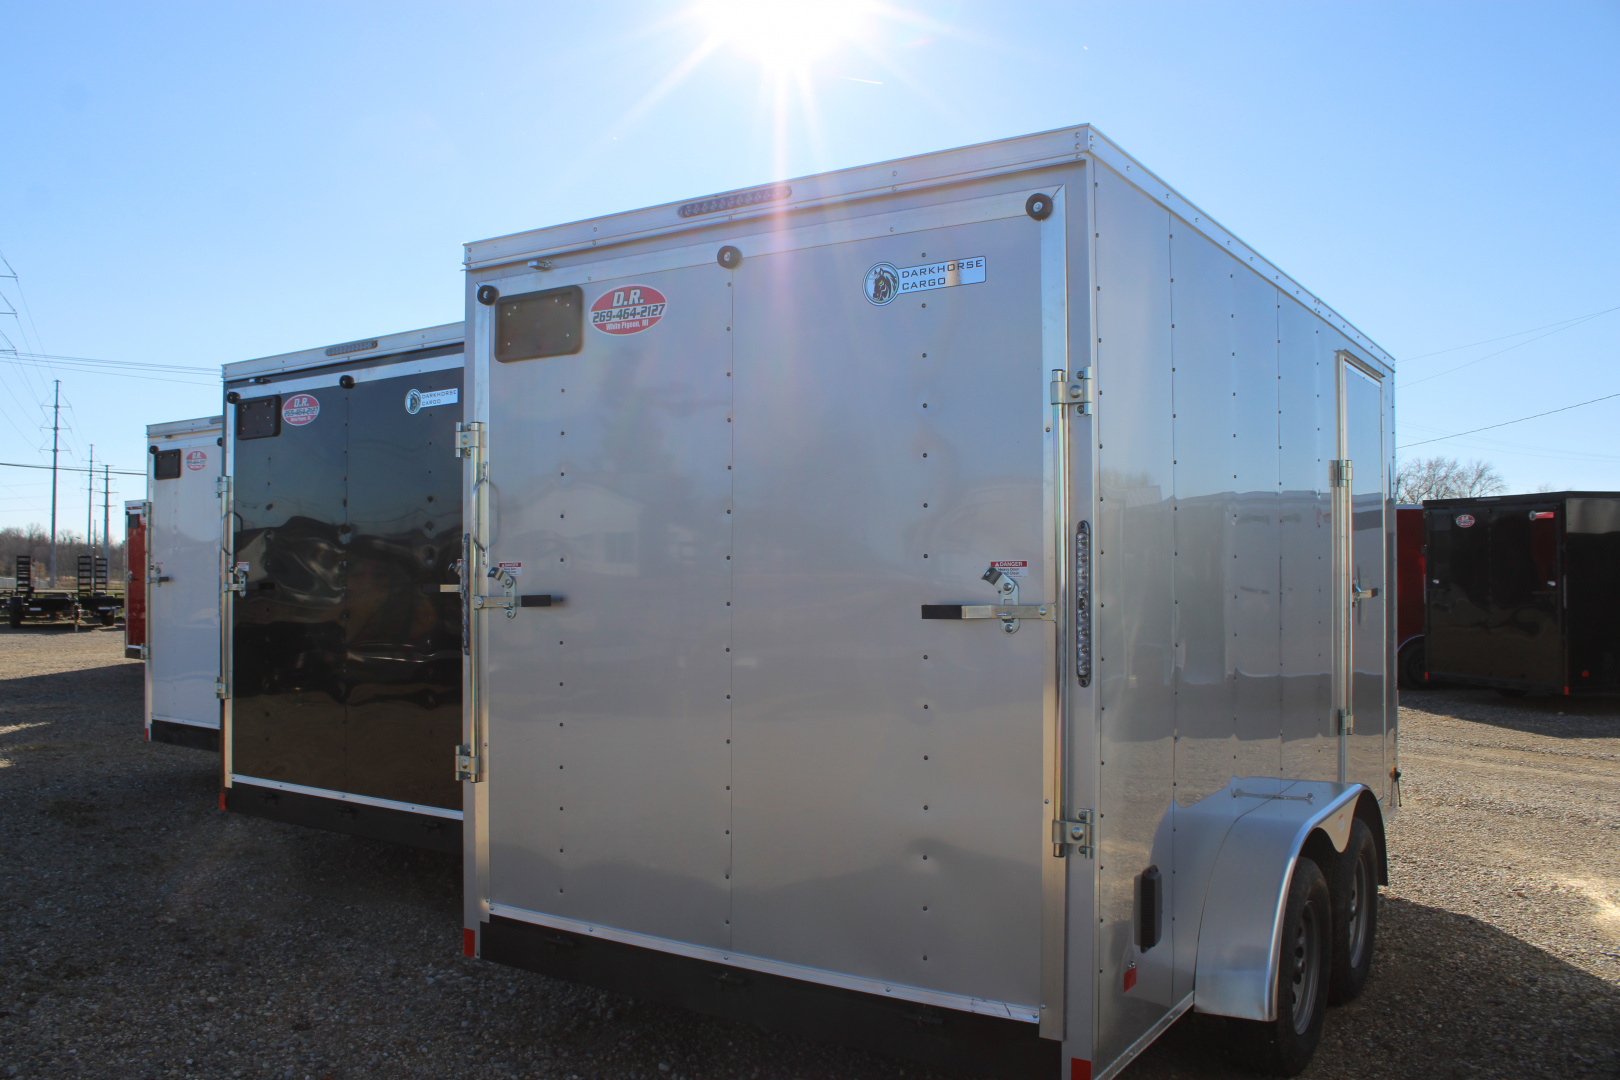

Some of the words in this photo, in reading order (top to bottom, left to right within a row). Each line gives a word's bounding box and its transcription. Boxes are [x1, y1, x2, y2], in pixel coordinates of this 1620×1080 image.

[902, 259, 983, 279] DARKHORSE
[902, 277, 946, 291] CARGO
[612, 288, 645, 308] D.R.
[592, 303, 666, 324] 269-464-2127
[294, 397, 310, 408] D.R.
[421, 389, 457, 399] DARKHORSE
